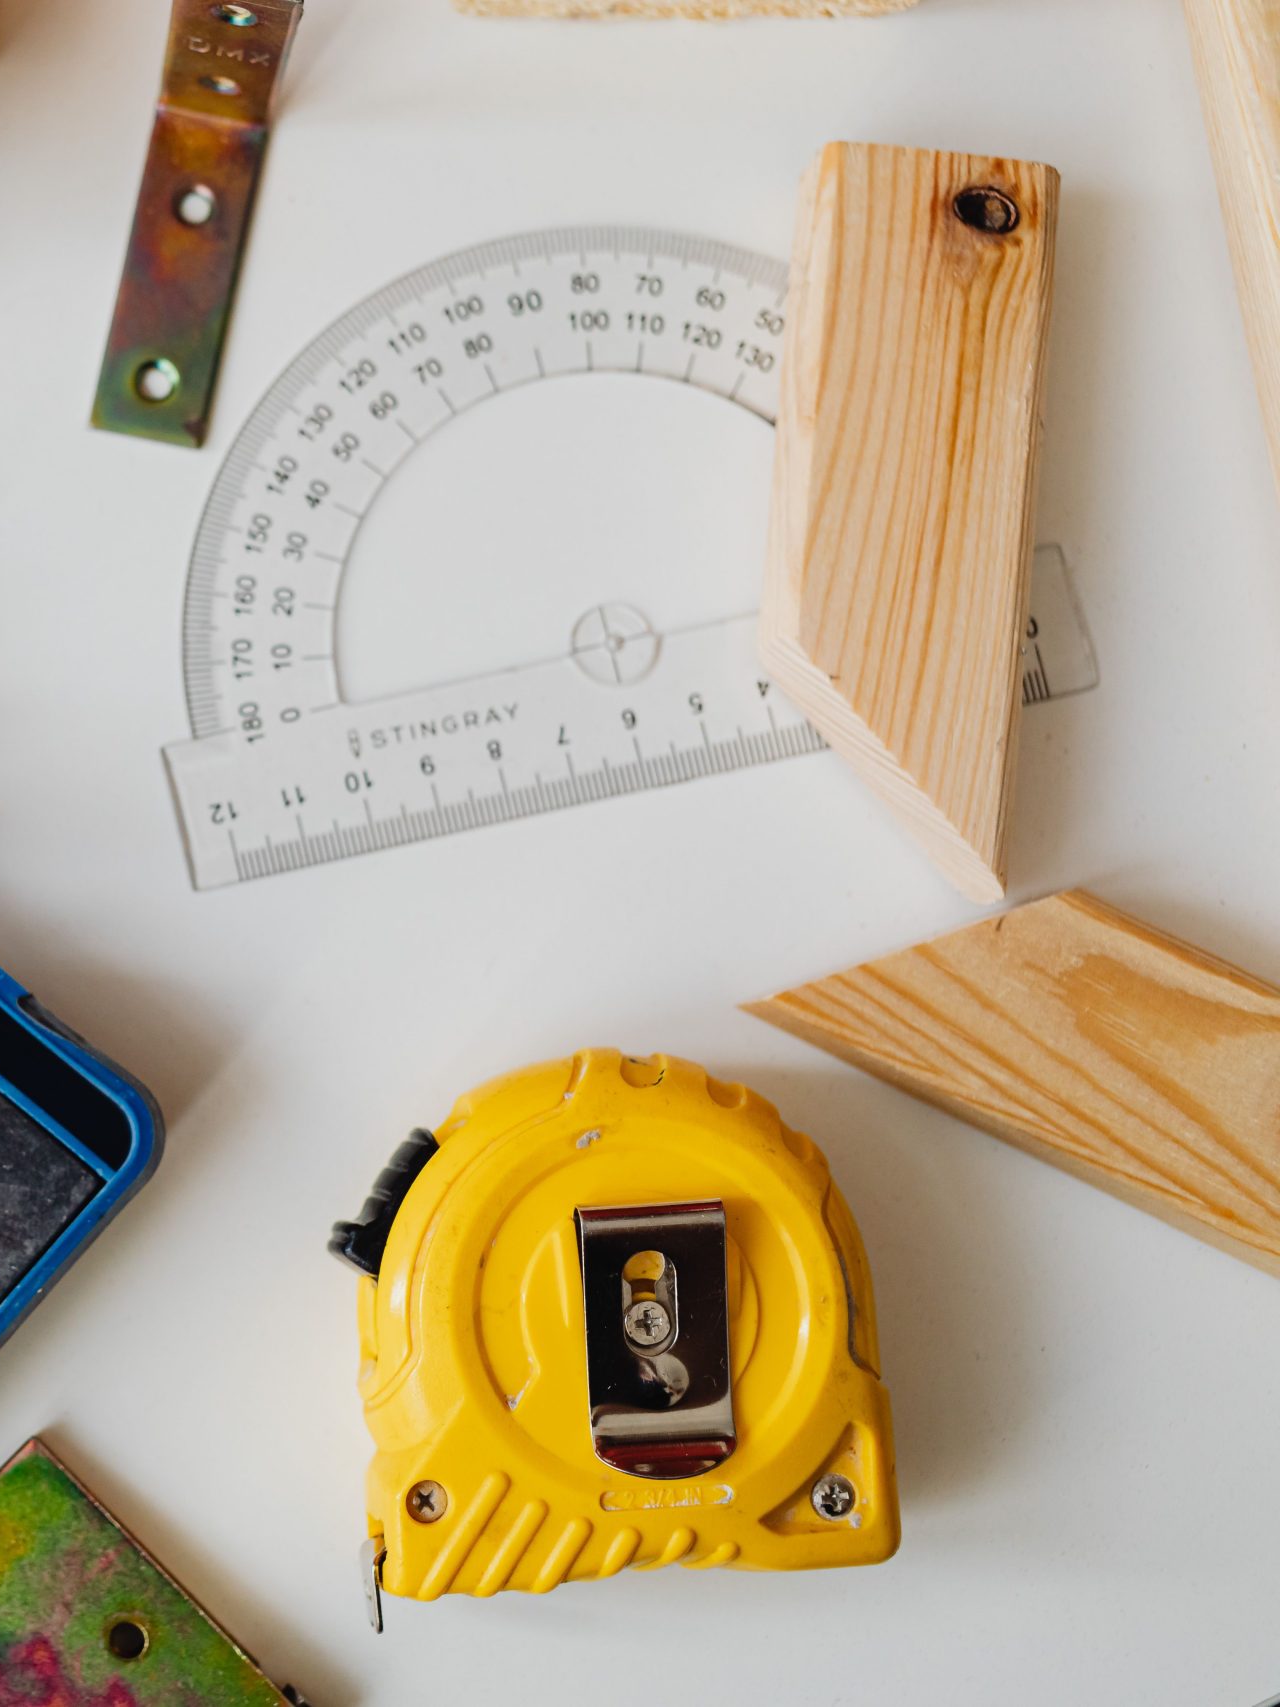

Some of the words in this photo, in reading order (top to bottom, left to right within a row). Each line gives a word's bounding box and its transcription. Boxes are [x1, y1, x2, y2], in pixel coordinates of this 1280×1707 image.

[188, 36, 270, 67] DMX
[570, 273, 600, 294] 80
[635, 273, 664, 297] 70
[442, 295, 485, 324] 100
[507, 289, 543, 316] 90
[696, 287, 726, 311] 60
[568, 310, 610, 332] 100
[625, 312, 665, 335] 110
[754, 310, 785, 335] 50
[387, 323, 427, 355] 110
[462, 333, 493, 359] 80
[681, 321, 722, 349] 120
[412, 357, 443, 384] 70
[735, 341, 775, 373] 130
[338, 359, 378, 394] 120
[370, 391, 399, 420] 60
[298, 404, 334, 441] 130
[332, 432, 360, 462] 50
[265, 455, 299, 495] 140
[304, 479, 331, 509] 40
[245, 513, 272, 554] 150
[283, 532, 308, 561] 30
[234, 574, 256, 616] 160
[272, 587, 295, 617] 20
[232, 638, 254, 680] 170
[271, 643, 292, 672] 10
[757, 680, 769, 697] 4
[280, 707, 302, 724] 0
[688, 692, 704, 715] 5
[239, 702, 264, 744] 180
[369, 703, 518, 750] STINGRAY
[621, 709, 637, 730] 6
[557, 725, 570, 745] 7
[486, 740, 502, 761] 8
[420, 754, 436, 776] 9
[344, 770, 374, 793] 10
[281, 786, 306, 808] 11
[209, 800, 239, 825] 12
